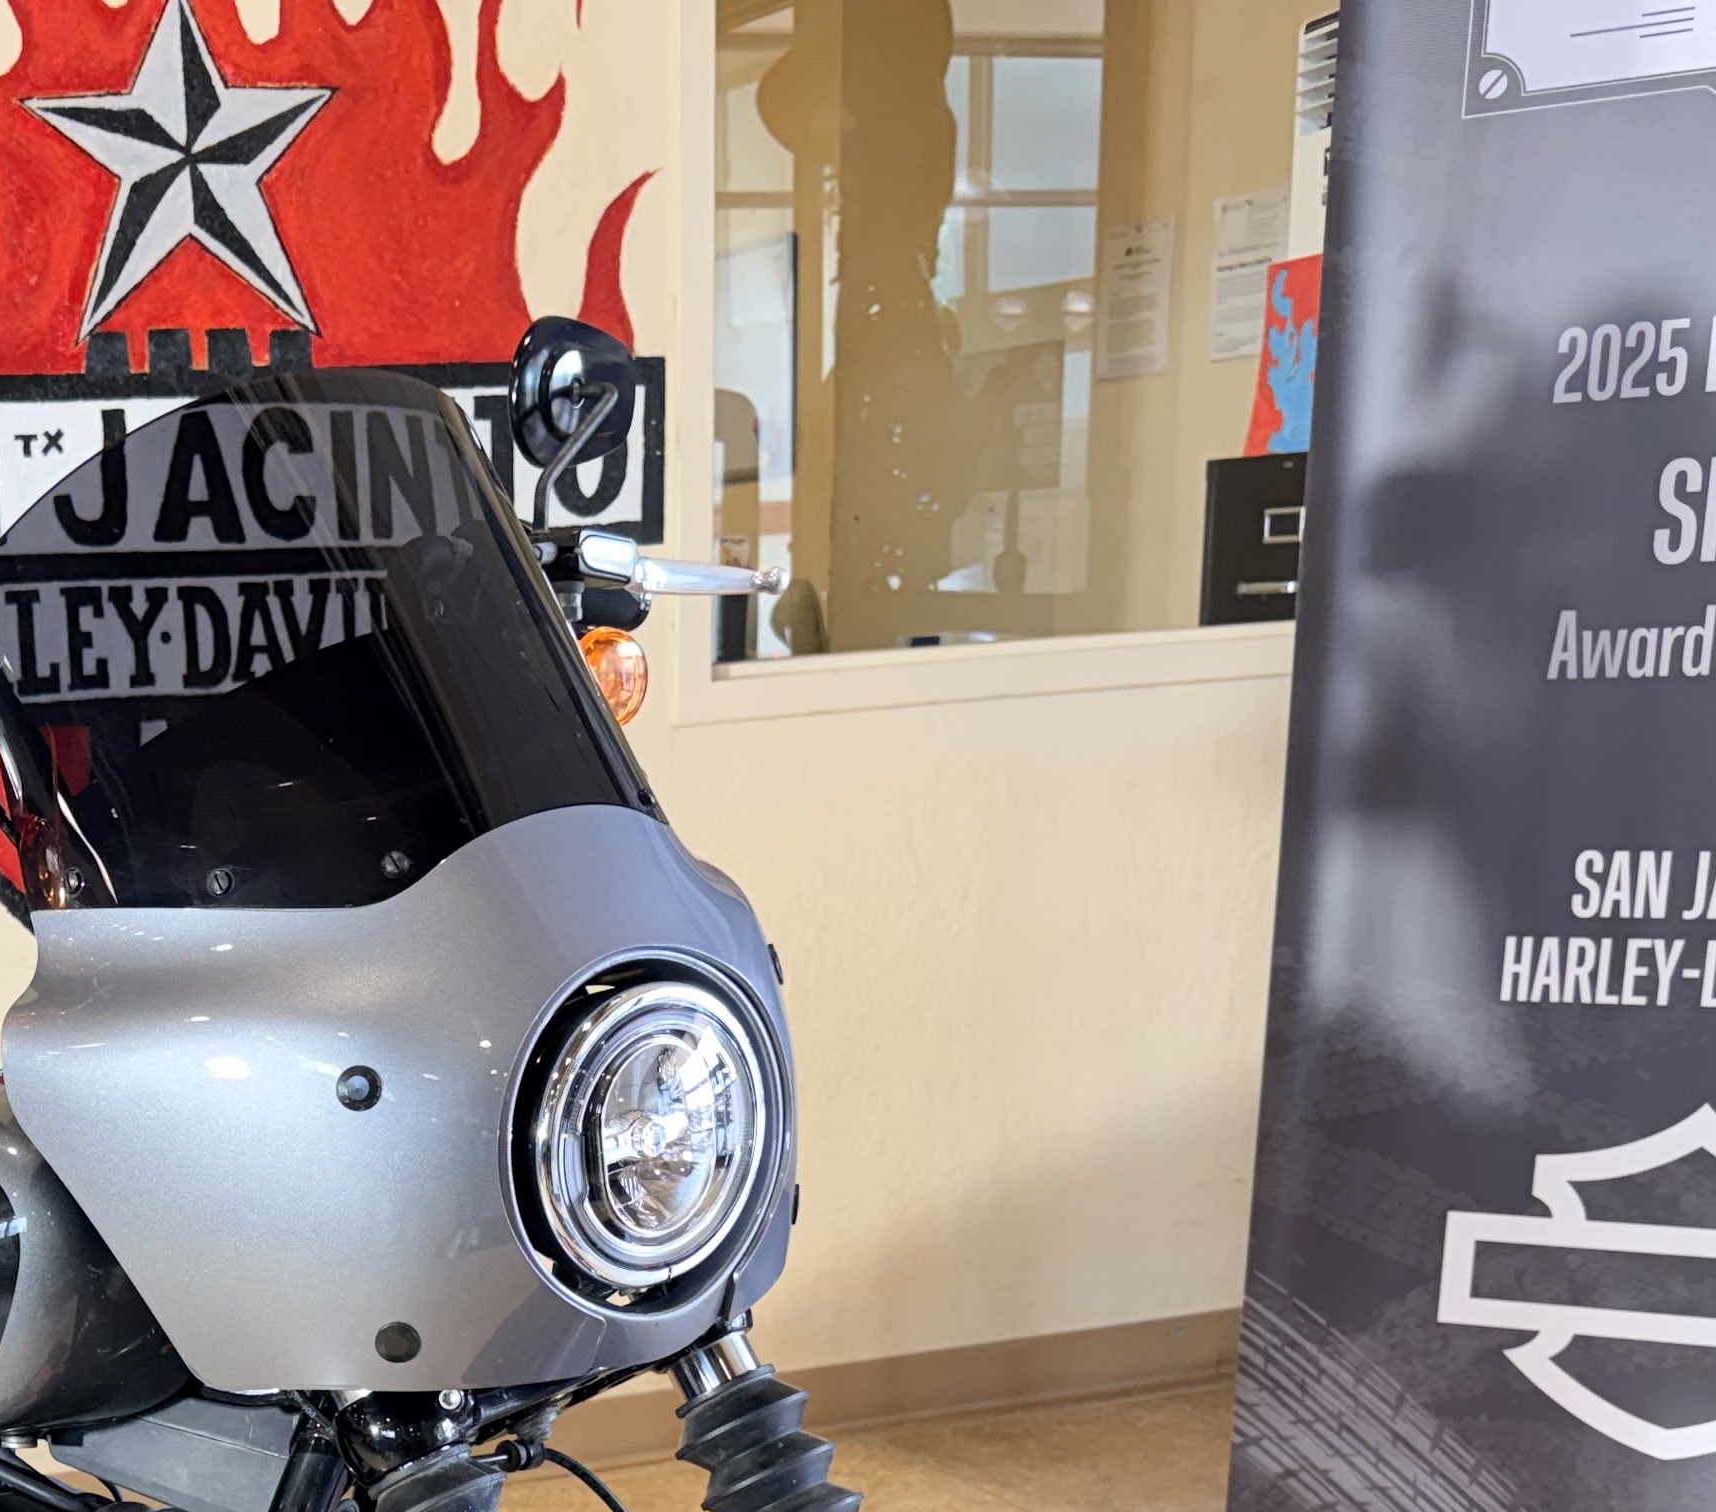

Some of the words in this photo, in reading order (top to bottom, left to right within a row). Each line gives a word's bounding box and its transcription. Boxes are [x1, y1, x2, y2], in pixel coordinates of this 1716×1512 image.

[1552, 317, 1690, 404] 2025
[15, 428, 65, 457] TX
[1571, 849, 1673, 919] SAN
